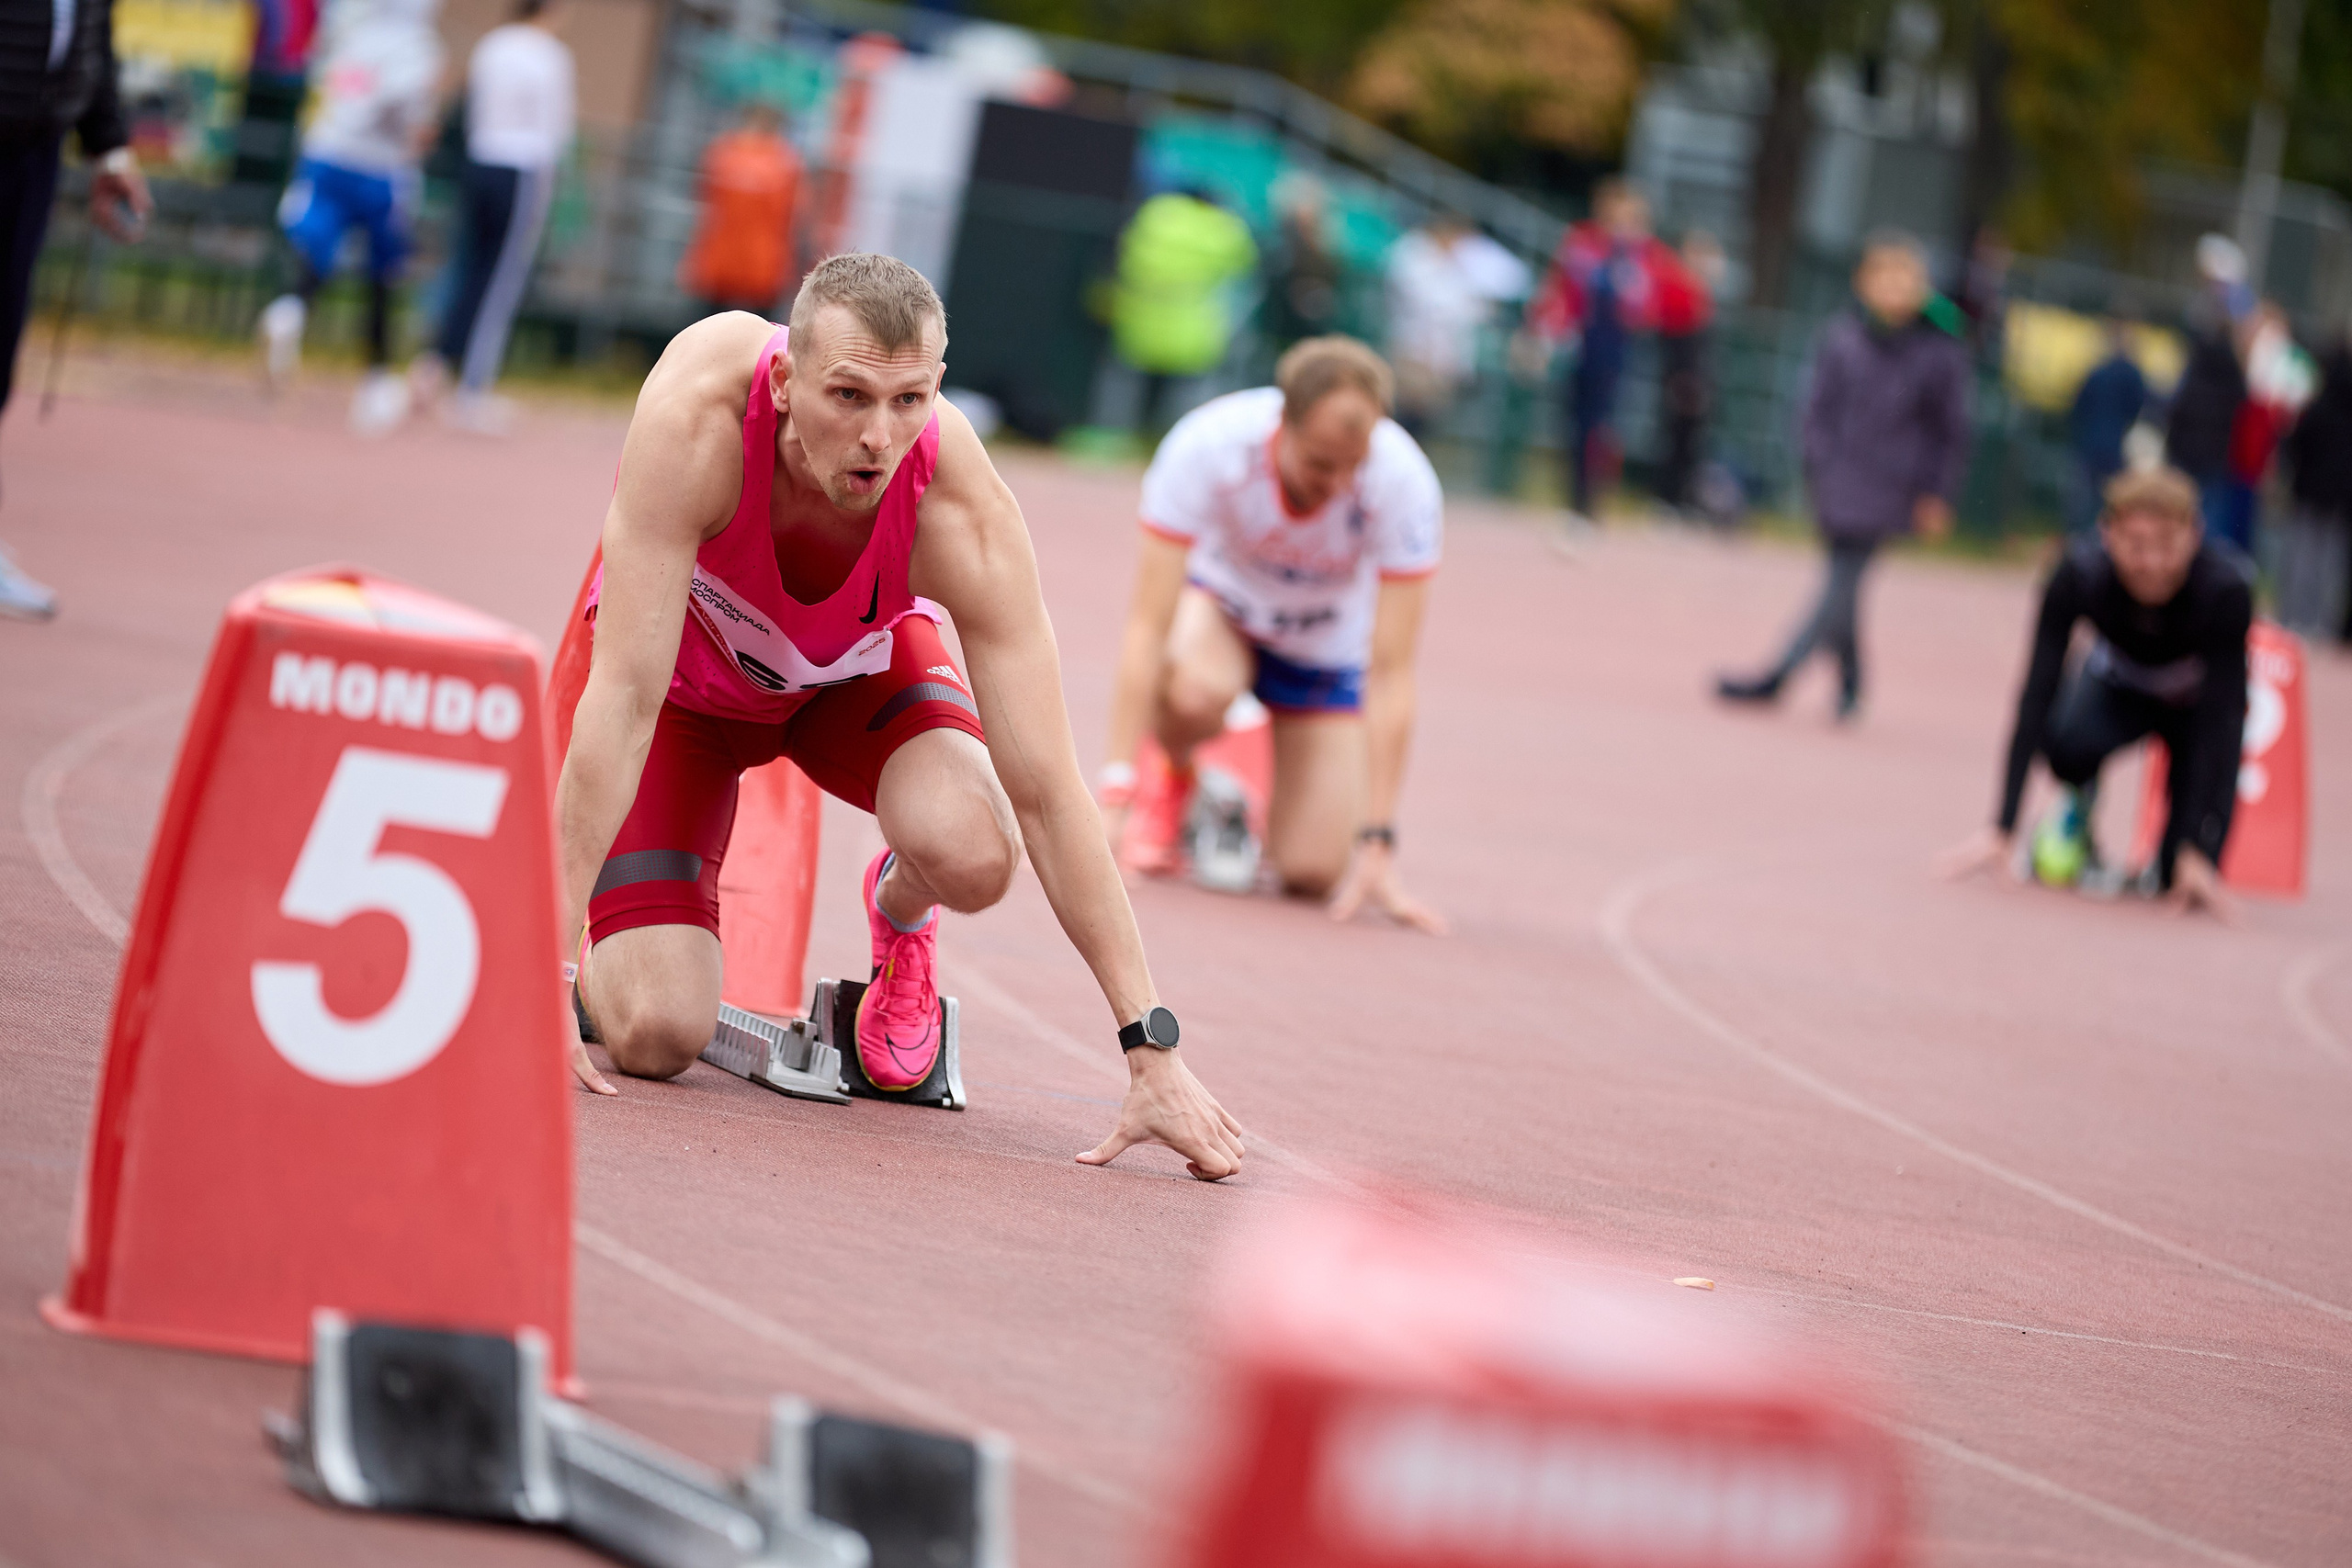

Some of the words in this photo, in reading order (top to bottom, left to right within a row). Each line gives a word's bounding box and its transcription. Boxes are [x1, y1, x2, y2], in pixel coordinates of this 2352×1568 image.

[691, 578, 770, 636] СПАРТАКИАДА
[858, 637, 886, 656] 2025
[270, 652, 523, 740] MONDO
[251, 746, 509, 1087] 5
